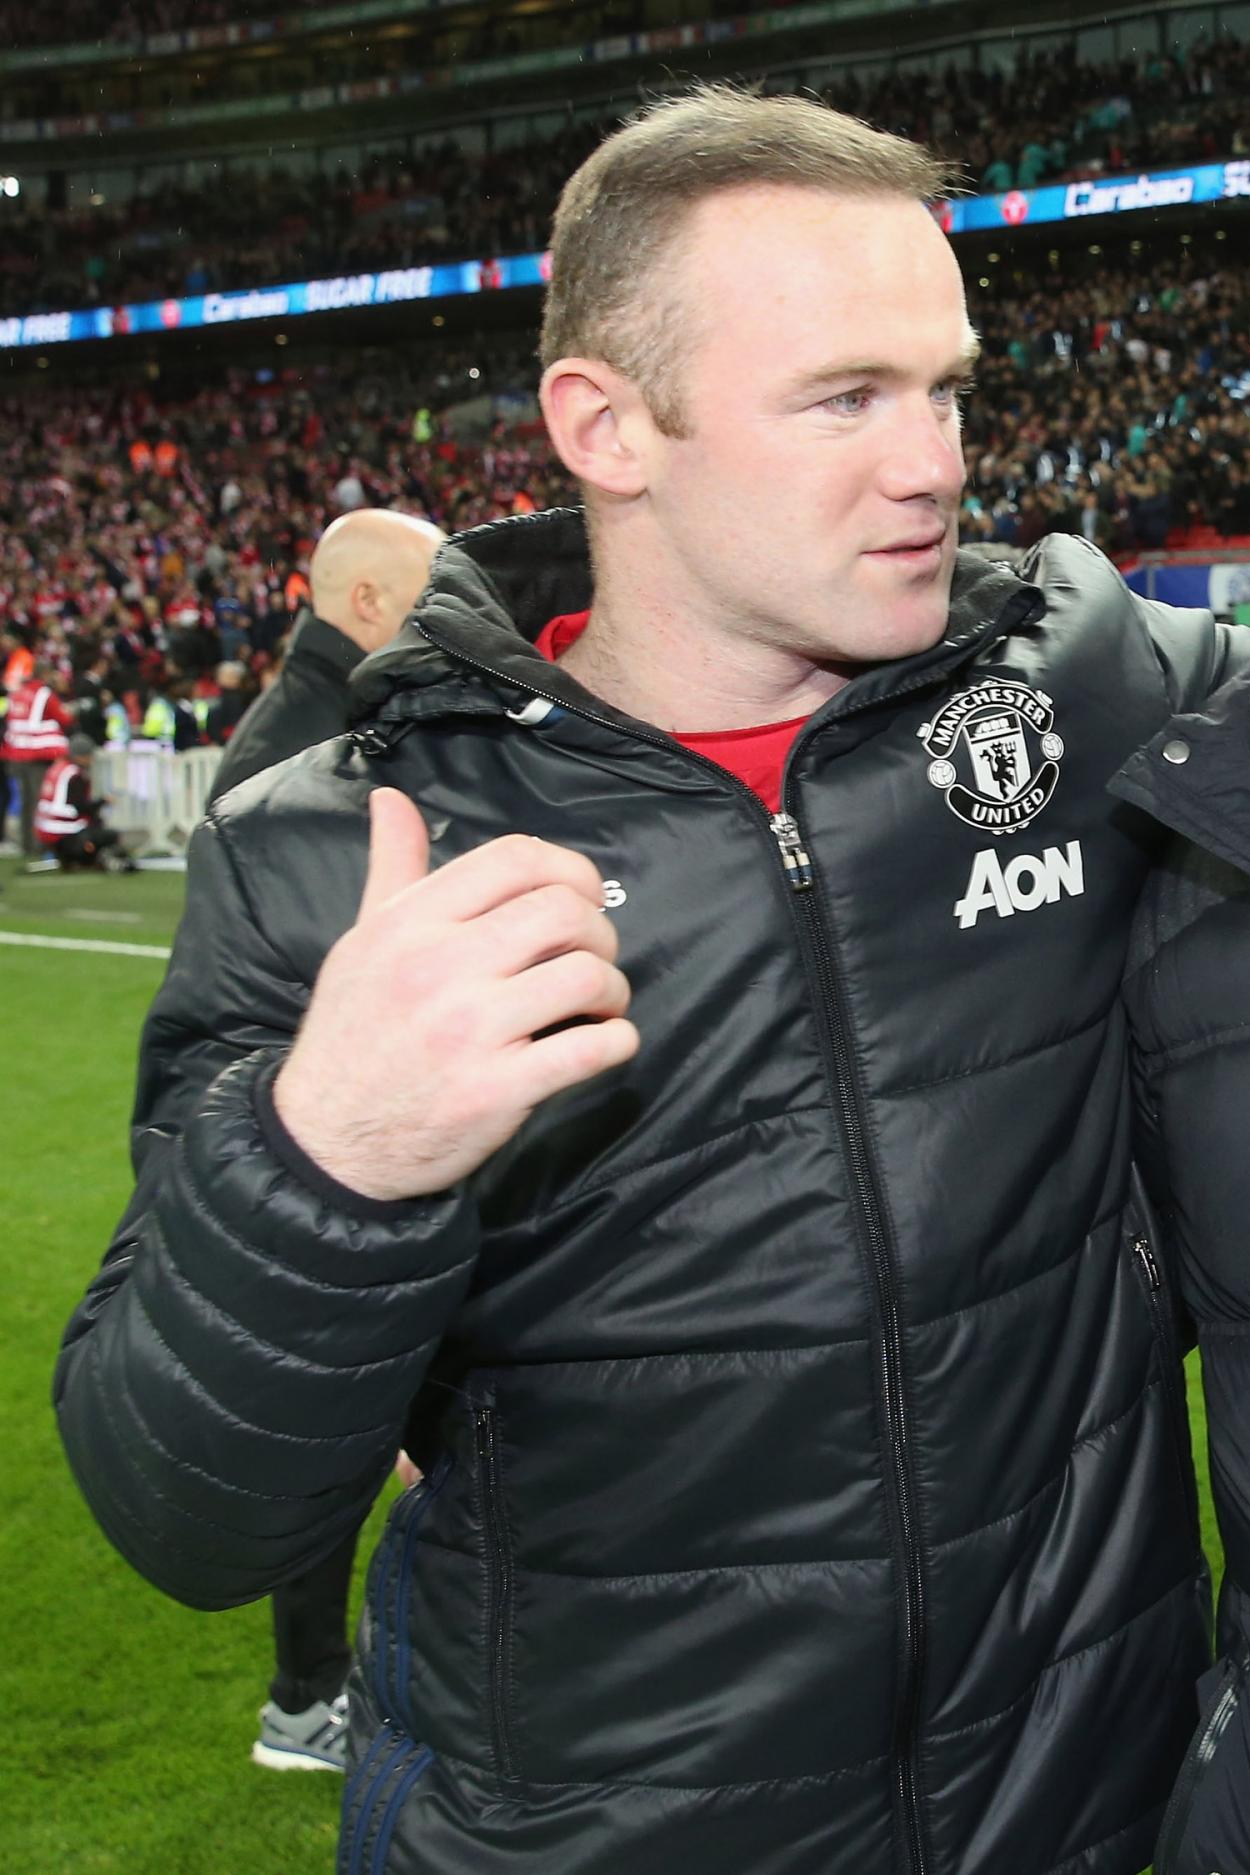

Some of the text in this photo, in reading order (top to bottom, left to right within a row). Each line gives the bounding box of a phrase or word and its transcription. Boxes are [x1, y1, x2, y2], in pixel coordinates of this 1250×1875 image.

[1065, 175, 1193, 217] Carabao
[933, 688, 1046, 747] MANCHESTER
[971, 787, 1045, 824] UNITED
[953, 840, 1085, 929] AON
